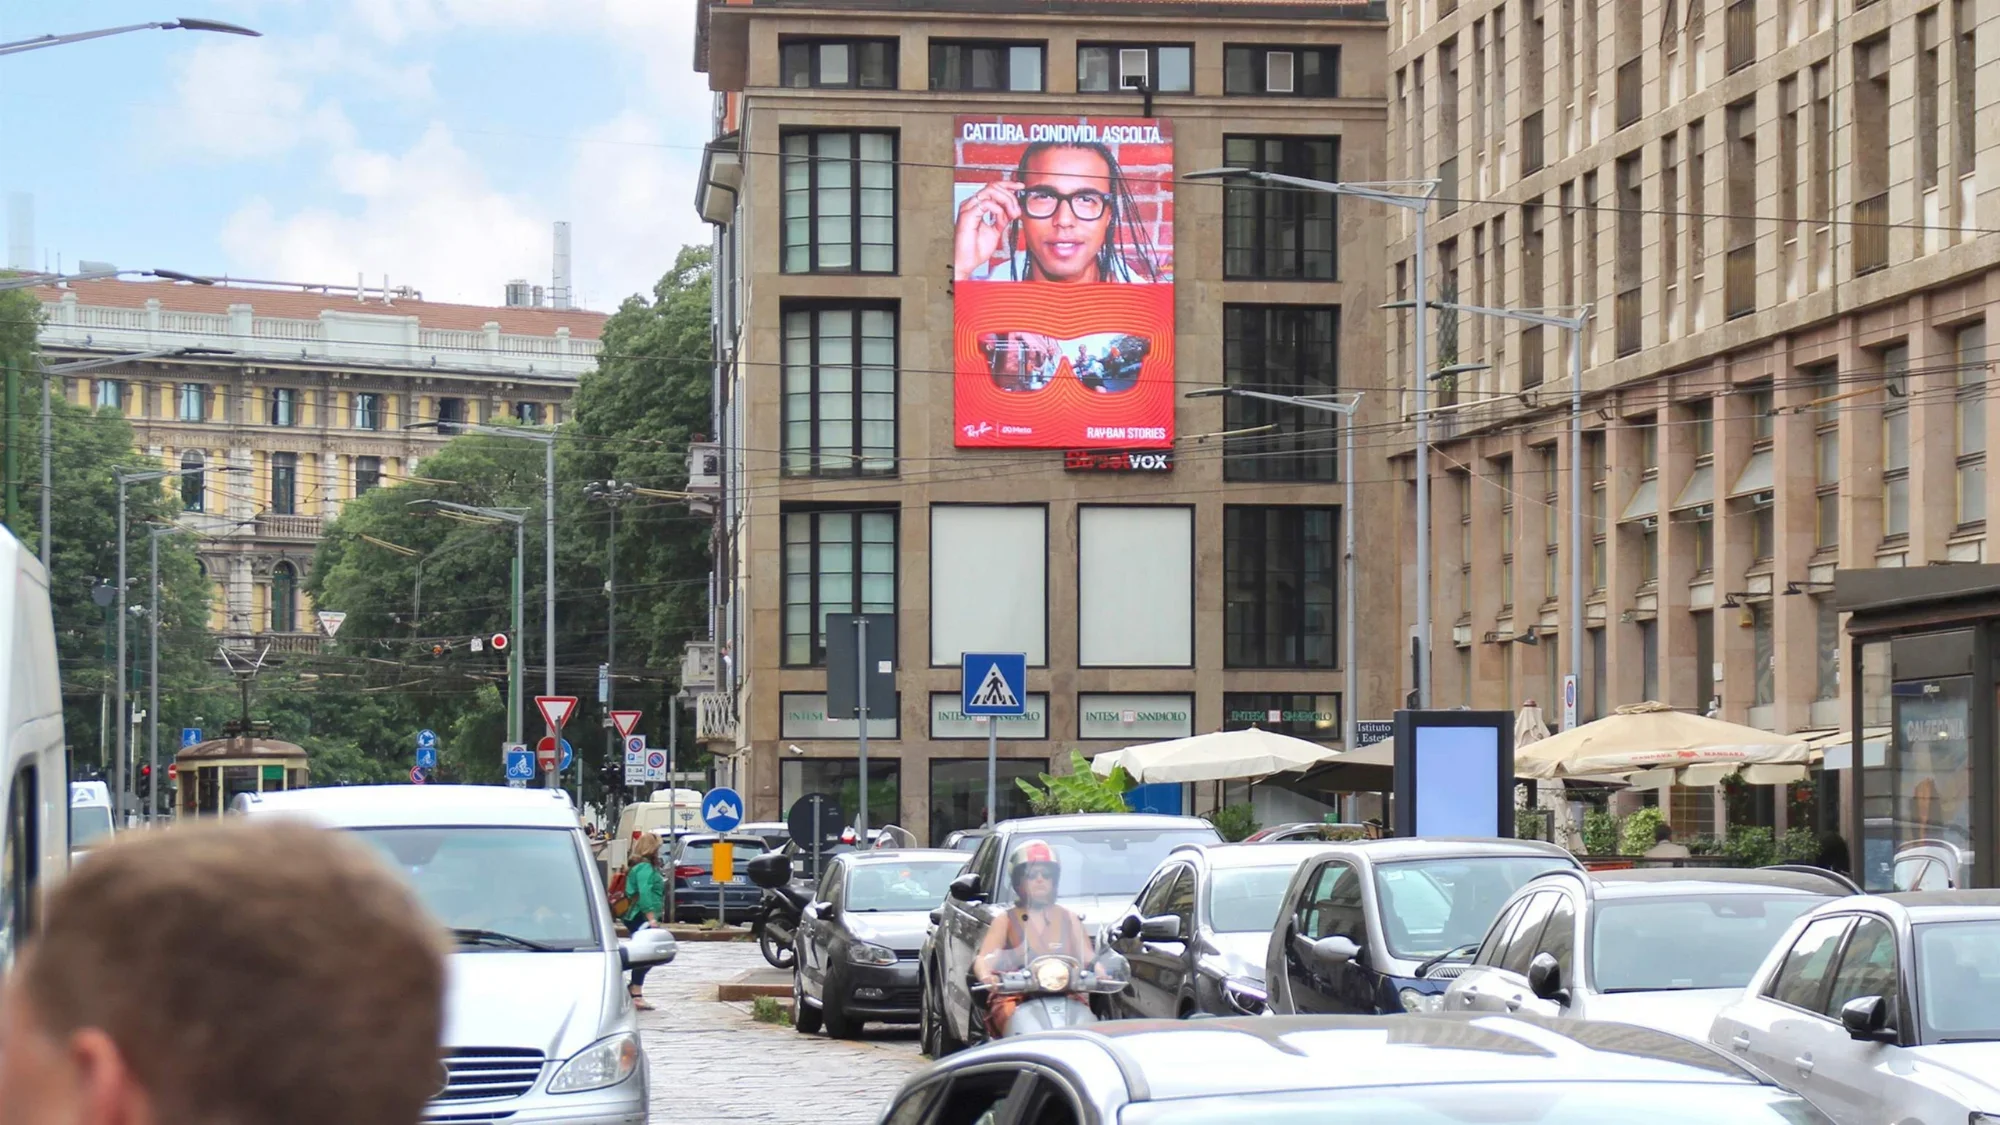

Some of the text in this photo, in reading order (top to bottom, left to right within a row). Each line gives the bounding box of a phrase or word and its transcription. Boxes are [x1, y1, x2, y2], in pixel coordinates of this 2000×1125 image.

[963, 123, 1164, 143] CATTURA. CONDIVIDI. ASCOLTA.
[1127, 427, 1166, 439] STORIES
[1086, 711, 1187, 721] INTESA SANPAOLO
[1231, 711, 1332, 721] INTESA SANPAOLO
[1357, 723, 1391, 732] Istituto
